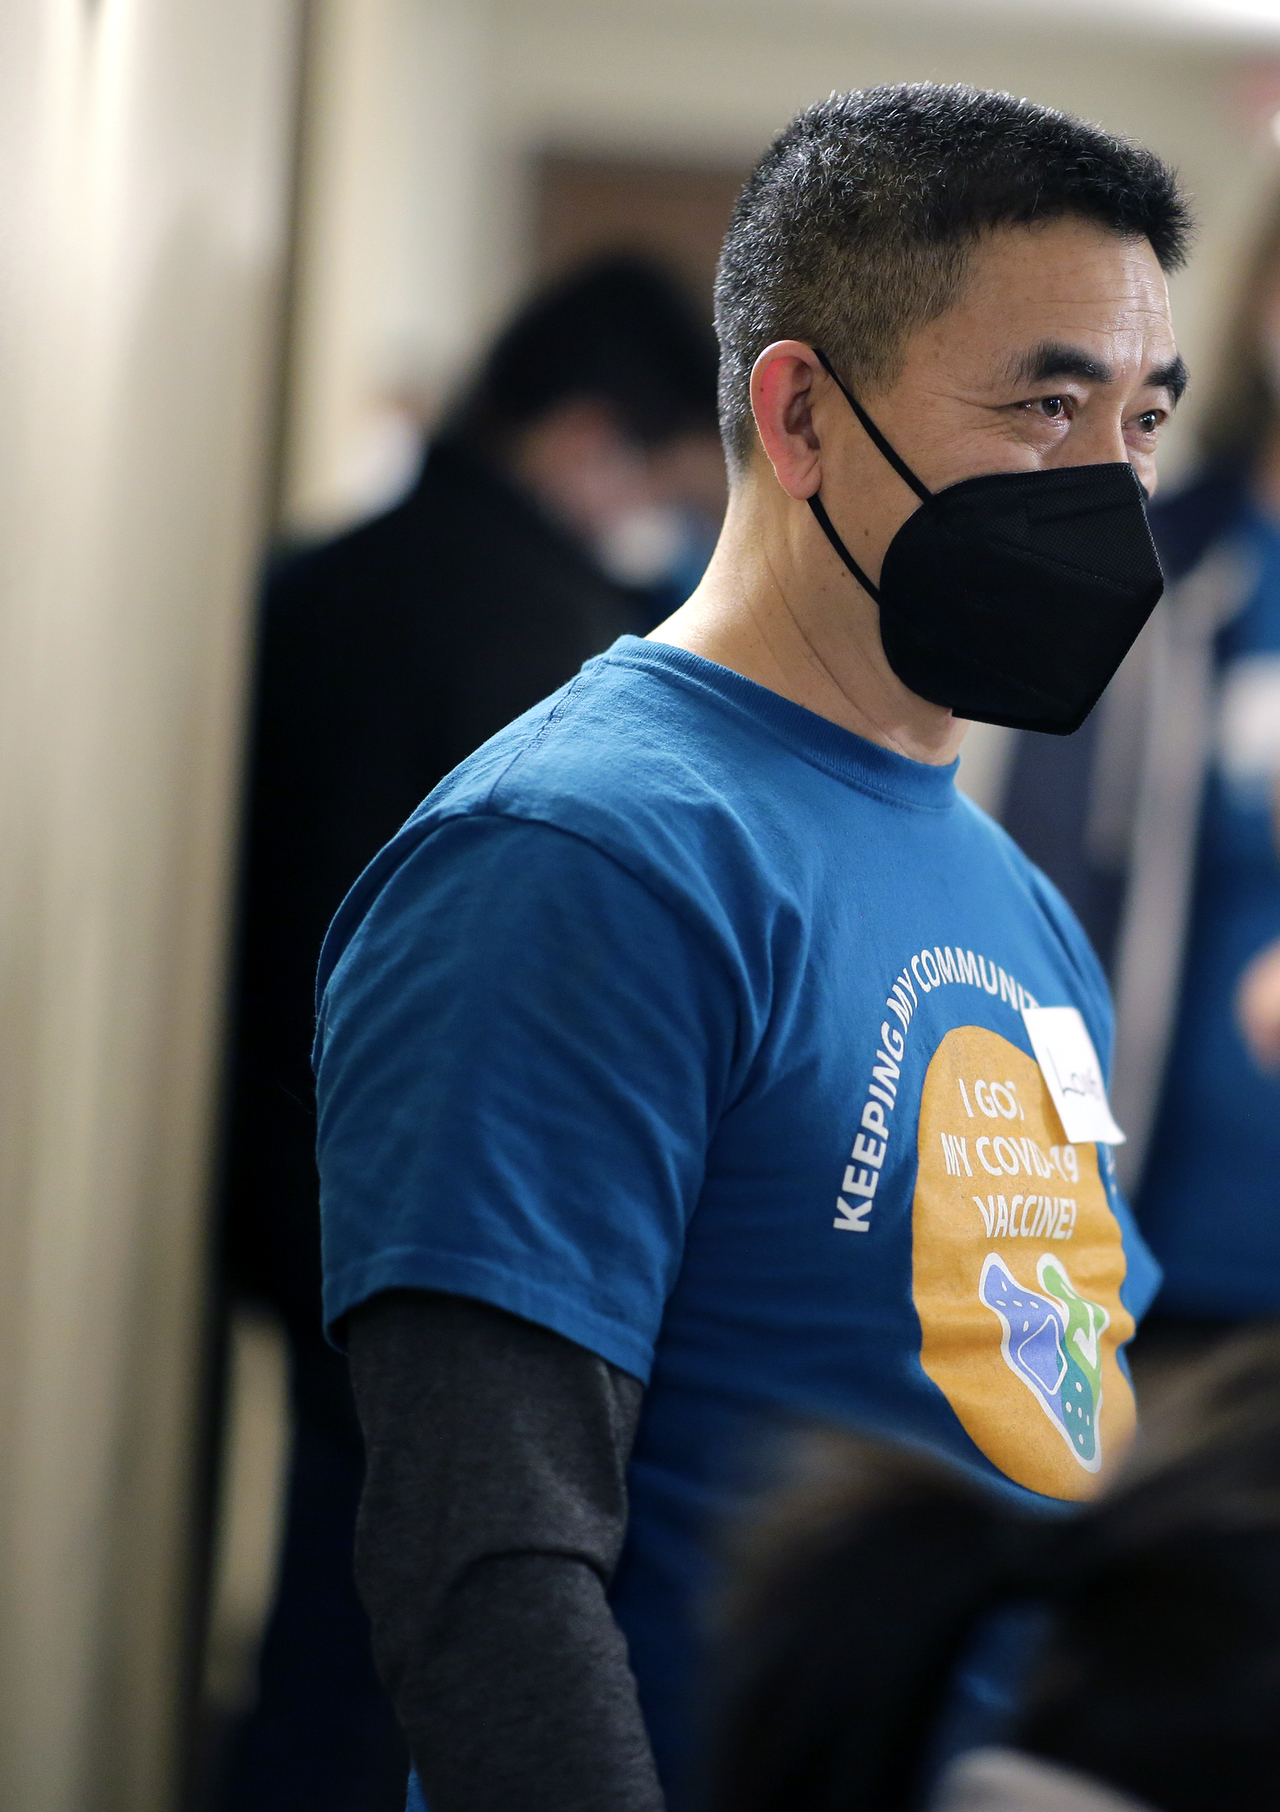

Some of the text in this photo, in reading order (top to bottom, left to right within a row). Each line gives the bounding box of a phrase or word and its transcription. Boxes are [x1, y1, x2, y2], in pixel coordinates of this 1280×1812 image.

[833, 1020, 904, 1233] KEEPING
[886, 967, 918, 1035] MY
[958, 1078, 975, 1118] I
[940, 1132, 974, 1177] MY
[975, 1136, 1080, 1184] COVID-19
[972, 1194, 1077, 1240] VACCINE!
